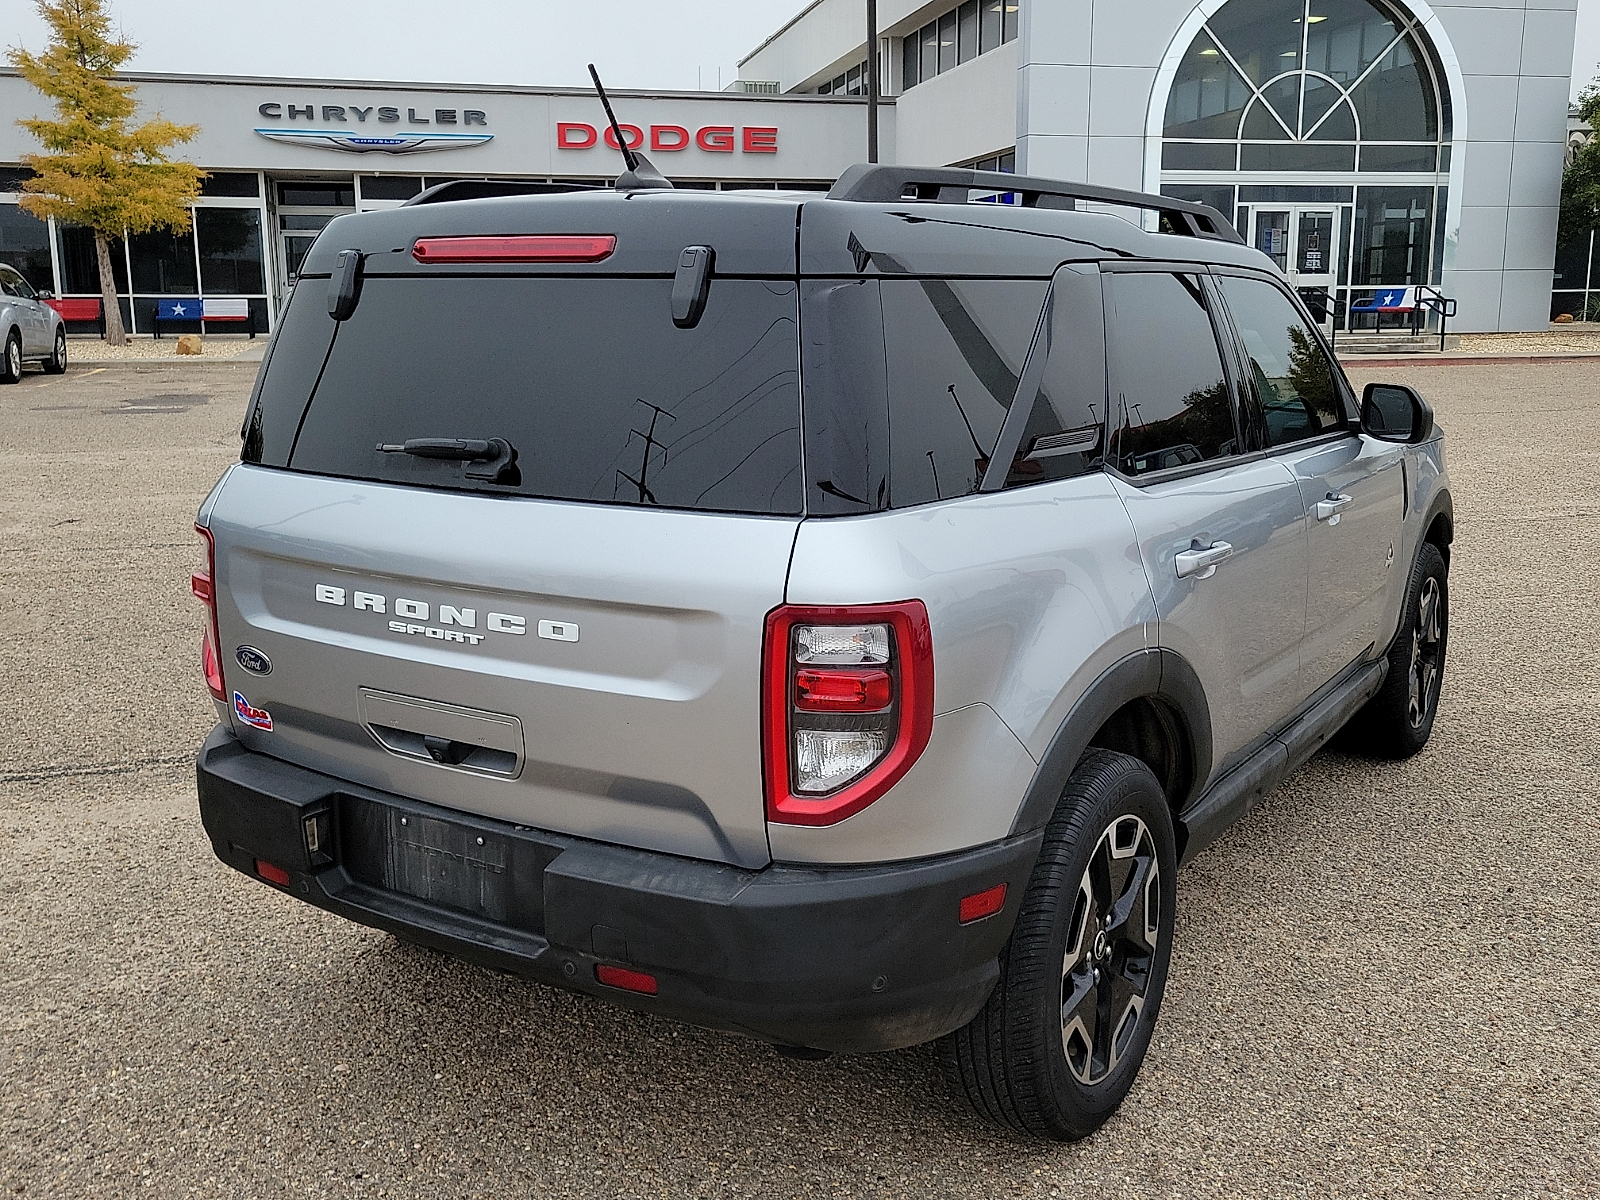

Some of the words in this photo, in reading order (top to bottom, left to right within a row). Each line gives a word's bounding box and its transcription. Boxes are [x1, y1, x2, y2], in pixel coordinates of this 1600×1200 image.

[258, 102, 488, 126] CHRYSLER
[556, 121, 779, 153] DODGE
[315, 583, 580, 642] BRONCO
[388, 620, 485, 645] SPORT
[241, 651, 262, 671] Ford
